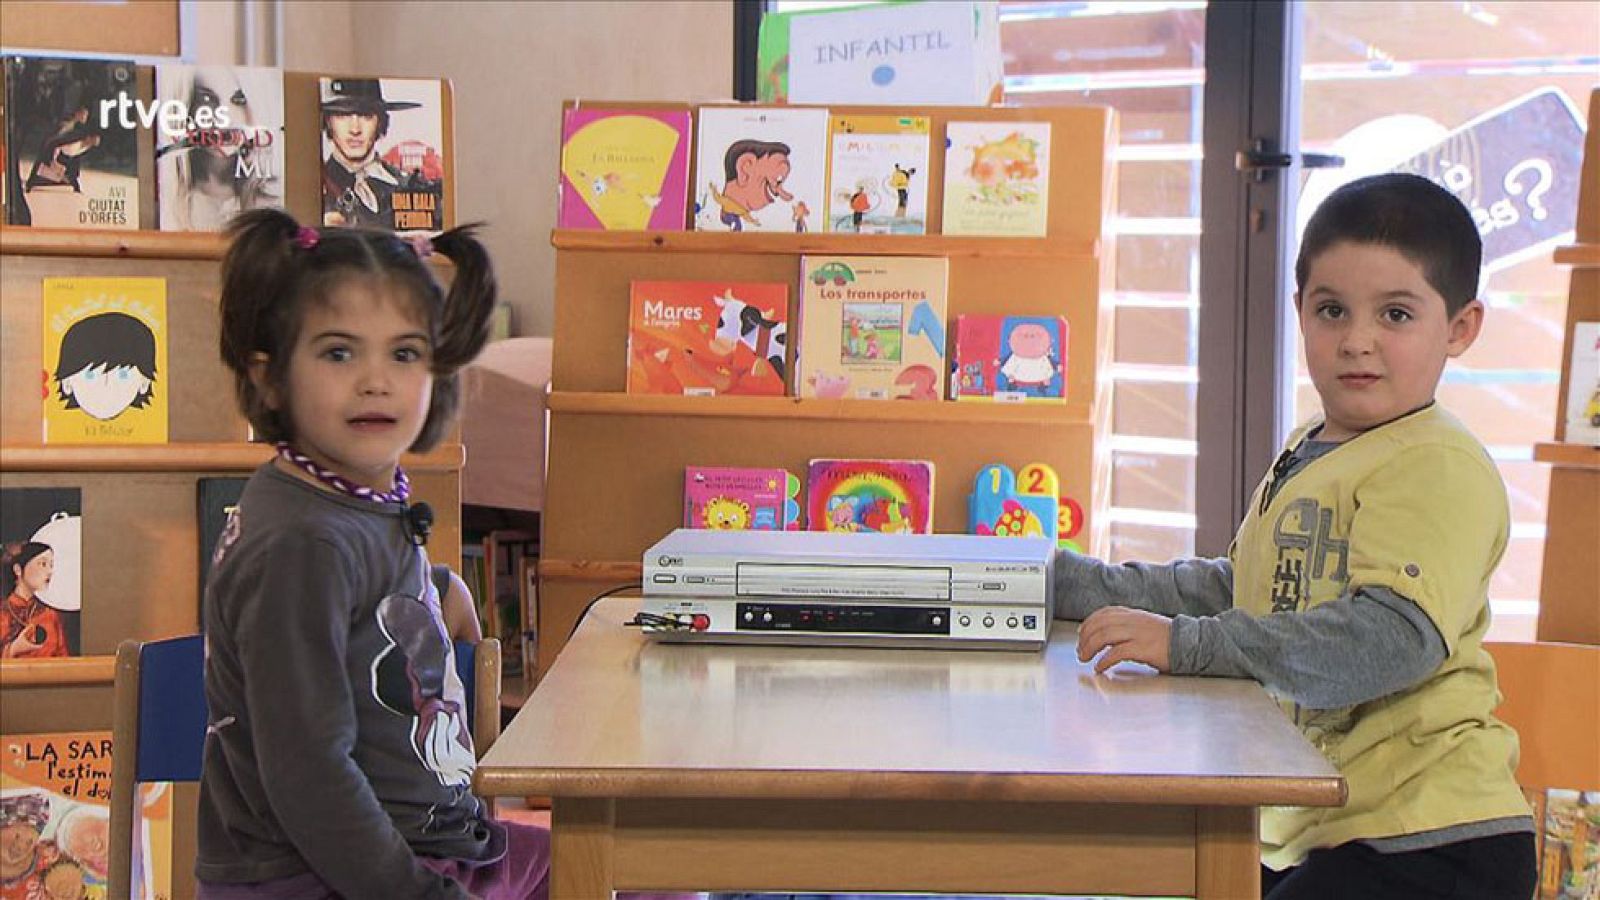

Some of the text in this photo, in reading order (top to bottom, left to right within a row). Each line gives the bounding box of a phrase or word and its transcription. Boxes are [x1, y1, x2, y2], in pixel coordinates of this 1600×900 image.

[814, 30, 951, 65] INFANTIL
[88, 198, 126, 212] CIUTAT
[79, 210, 127, 225] D'ORFES
[820, 287, 927, 304] Los transportes
[644, 299, 703, 321] Mares
[990, 467, 1045, 494] 1 2
[25, 740, 113, 762] LA SAR
[47, 760, 112, 780] l'estim
[62, 779, 79, 797] el
